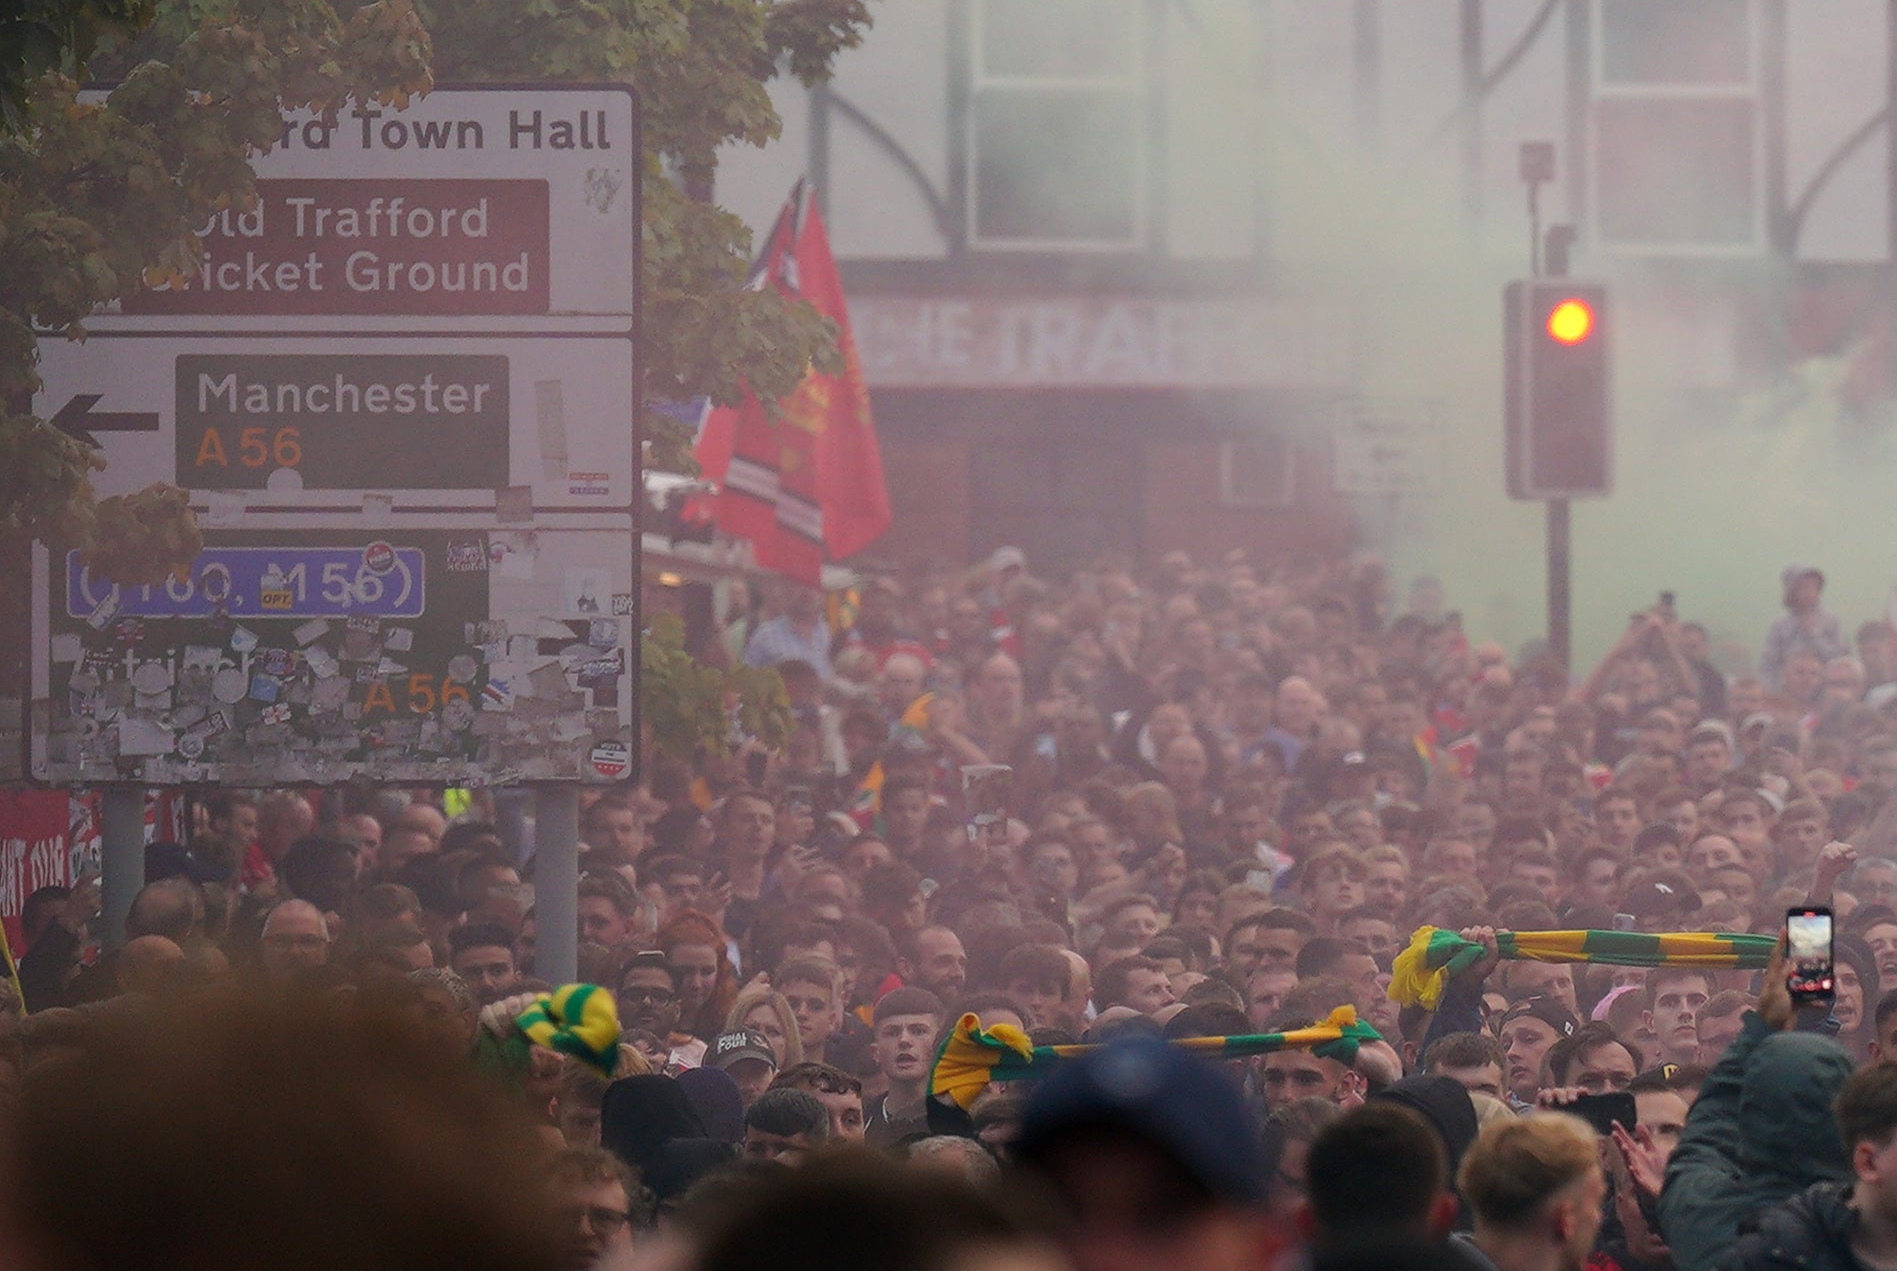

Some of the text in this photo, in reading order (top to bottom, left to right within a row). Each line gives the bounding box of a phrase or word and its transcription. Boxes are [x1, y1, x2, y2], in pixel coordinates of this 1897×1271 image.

[355, 110, 484, 150] Town
[509, 110, 611, 150] Hall
[286, 197, 488, 238] Trafford
[345, 250, 529, 292] Ground
[197, 372, 490, 415] Manchester
